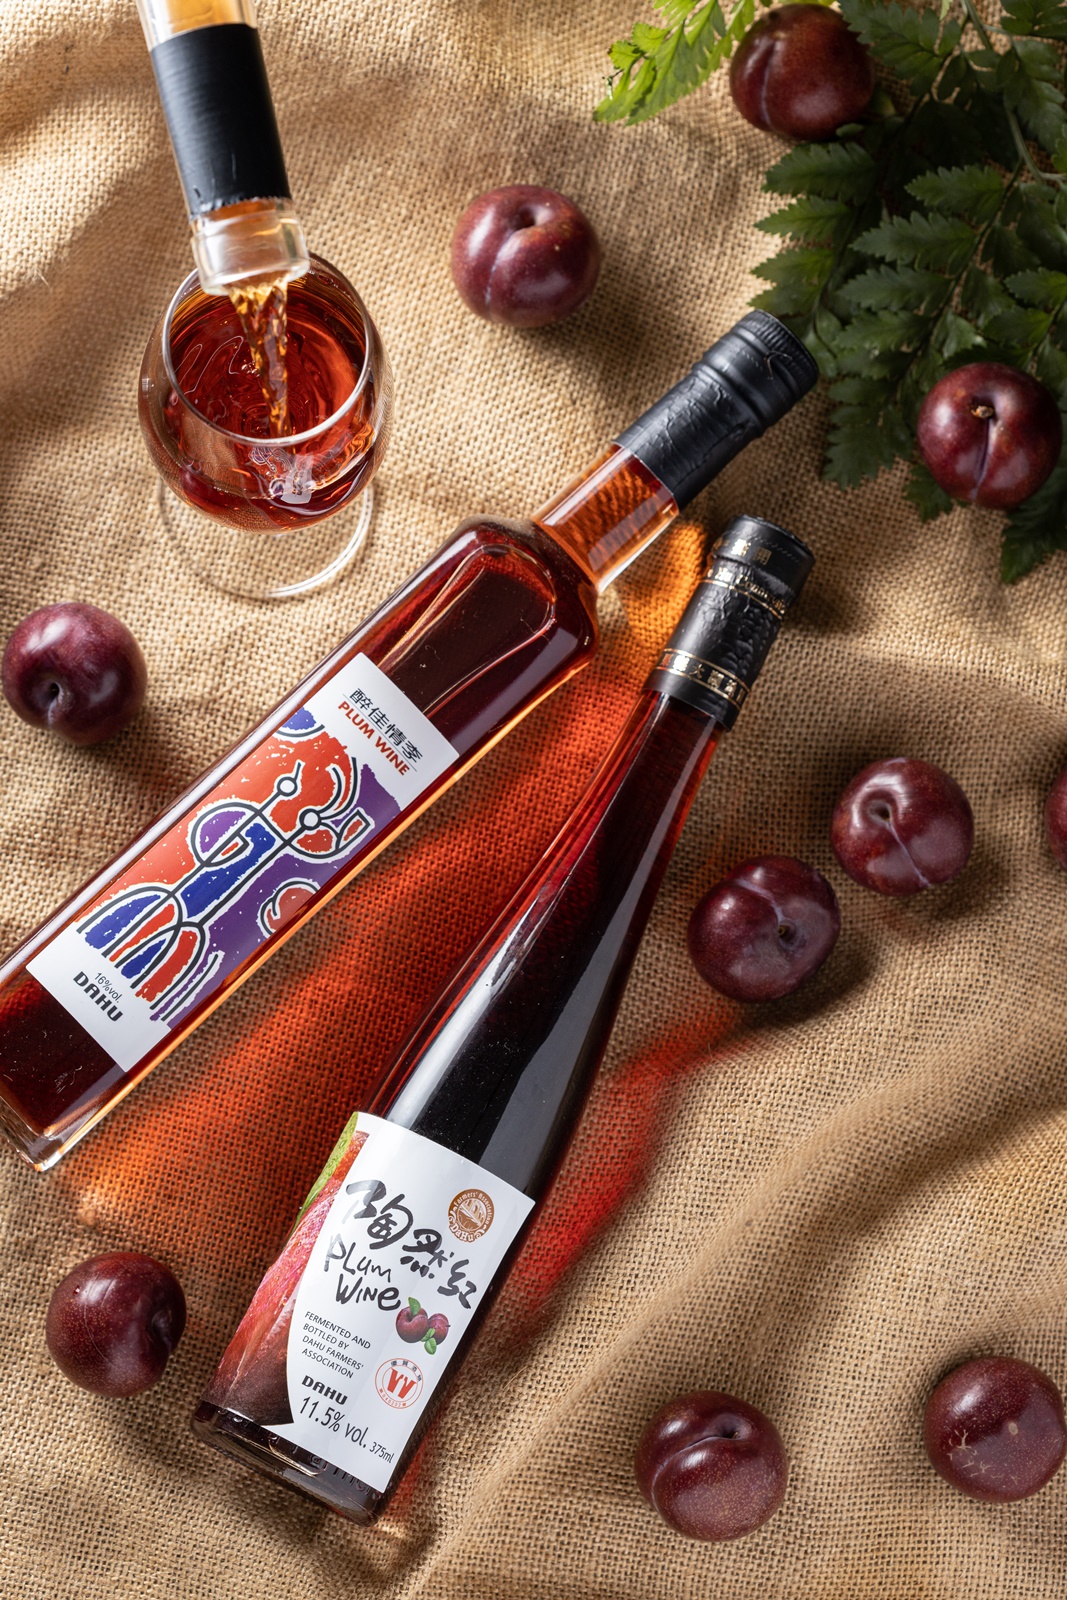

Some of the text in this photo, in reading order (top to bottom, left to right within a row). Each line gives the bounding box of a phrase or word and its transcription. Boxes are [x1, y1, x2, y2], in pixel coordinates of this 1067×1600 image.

[338, 701, 410, 776] PLUM WINE
[349, 688, 423, 763] 醉佳情李
[73, 971, 124, 1022] DAHU
[94, 972, 123, 1004] 16%vol.
[302, 1323, 350, 1350] BOTTLED BY
[304, 1311, 371, 1349] FERMENTED AND
[301, 1348, 354, 1379] ASSOCIATION
[302, 1335, 365, 1370] DAHU FARMERS'
[301, 1375, 348, 1405] DAHU
[300, 1396, 346, 1433] 11.5%
[344, 1423, 369, 1449] vol.
[369, 1441, 395, 1464] 375ml
